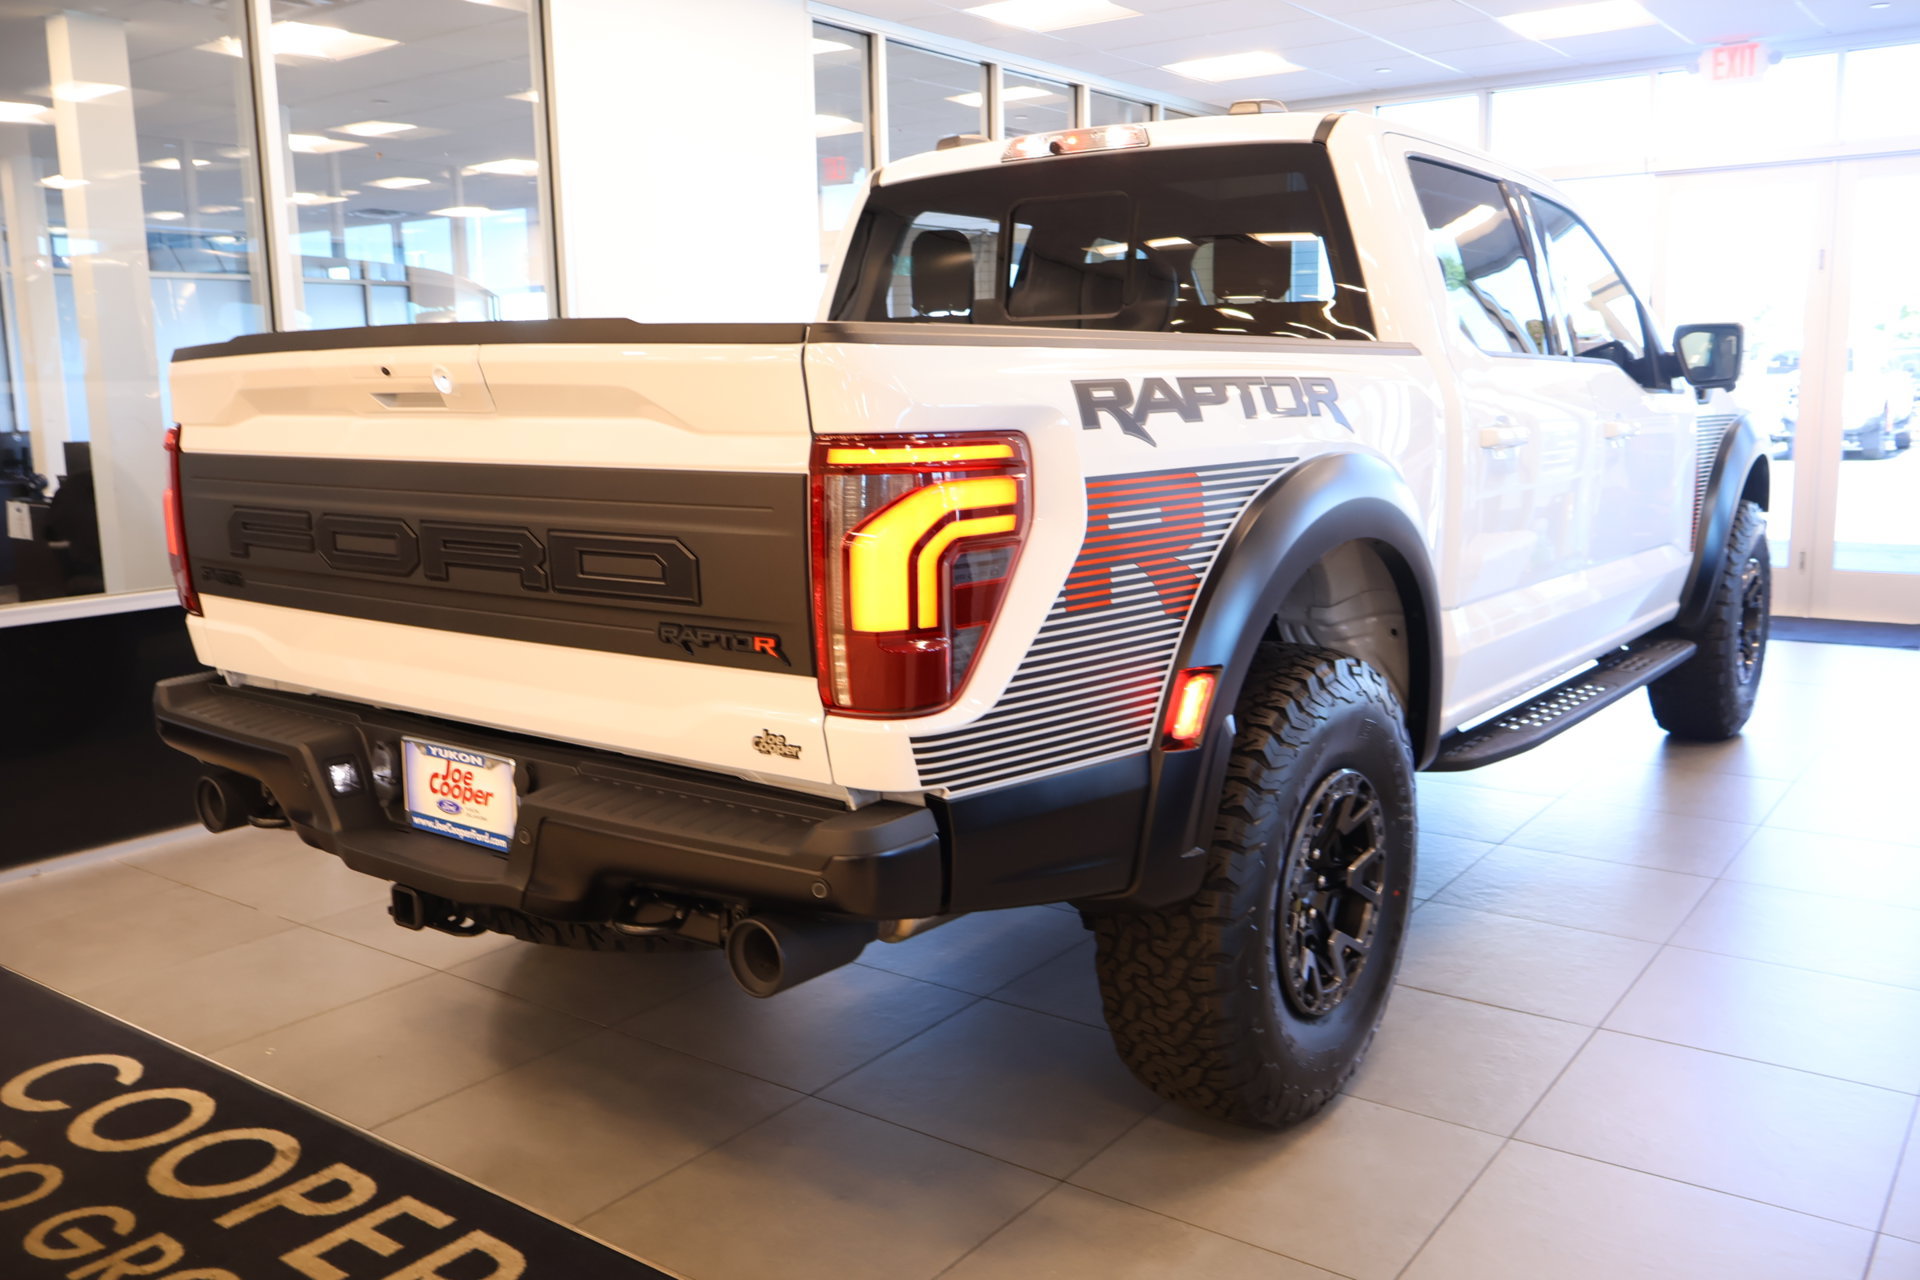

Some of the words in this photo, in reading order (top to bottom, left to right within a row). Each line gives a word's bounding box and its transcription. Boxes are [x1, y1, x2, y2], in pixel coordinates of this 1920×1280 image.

[1712, 42, 1760, 80] EXIT
[1070, 376, 1355, 447] RAPTOR
[228, 504, 702, 607] FORD
[658, 621, 791, 667] RAPTOR
[428, 745, 484, 767] YUKON
[441, 759, 474, 786] Joe
[429, 772, 494, 806] Cooper
